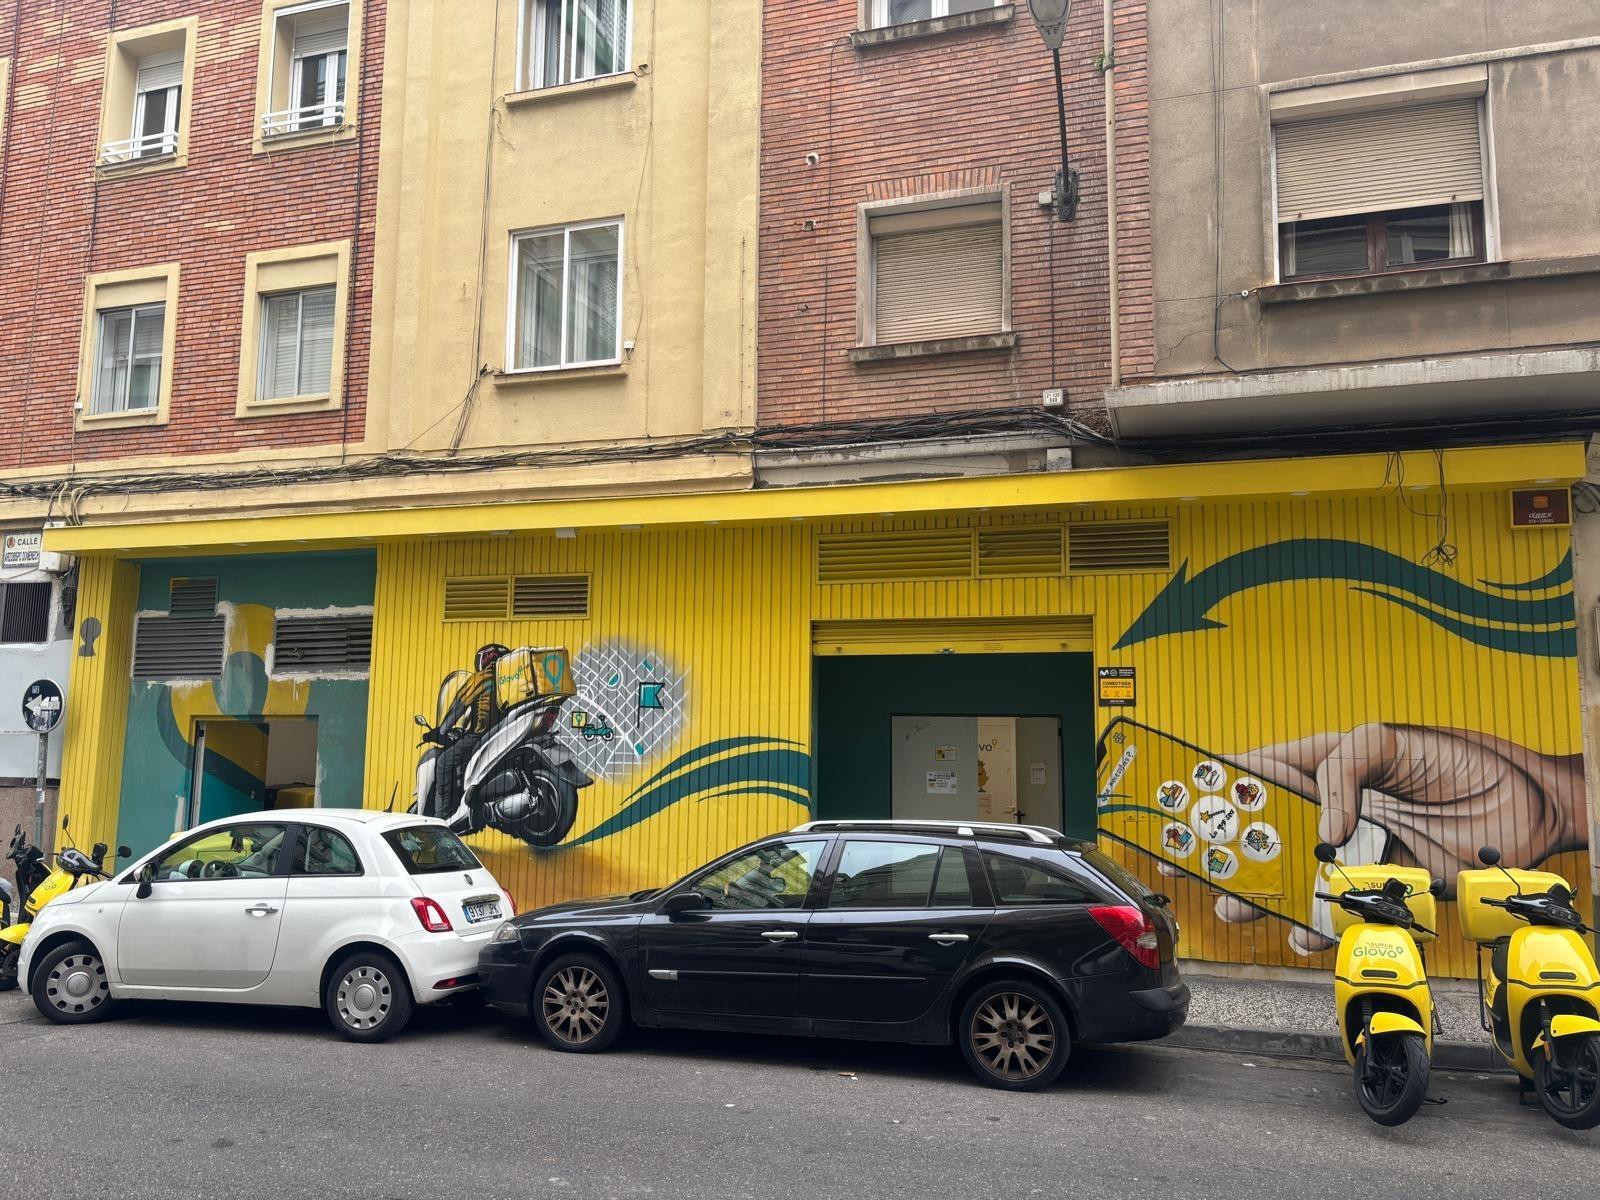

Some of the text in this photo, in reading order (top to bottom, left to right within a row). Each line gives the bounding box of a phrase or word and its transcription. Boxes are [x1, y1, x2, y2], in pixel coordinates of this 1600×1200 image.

[17, 537, 38, 546] CALLE
[468, 904, 485, 918] 9137
[1353, 946, 1400, 959] Glovo
